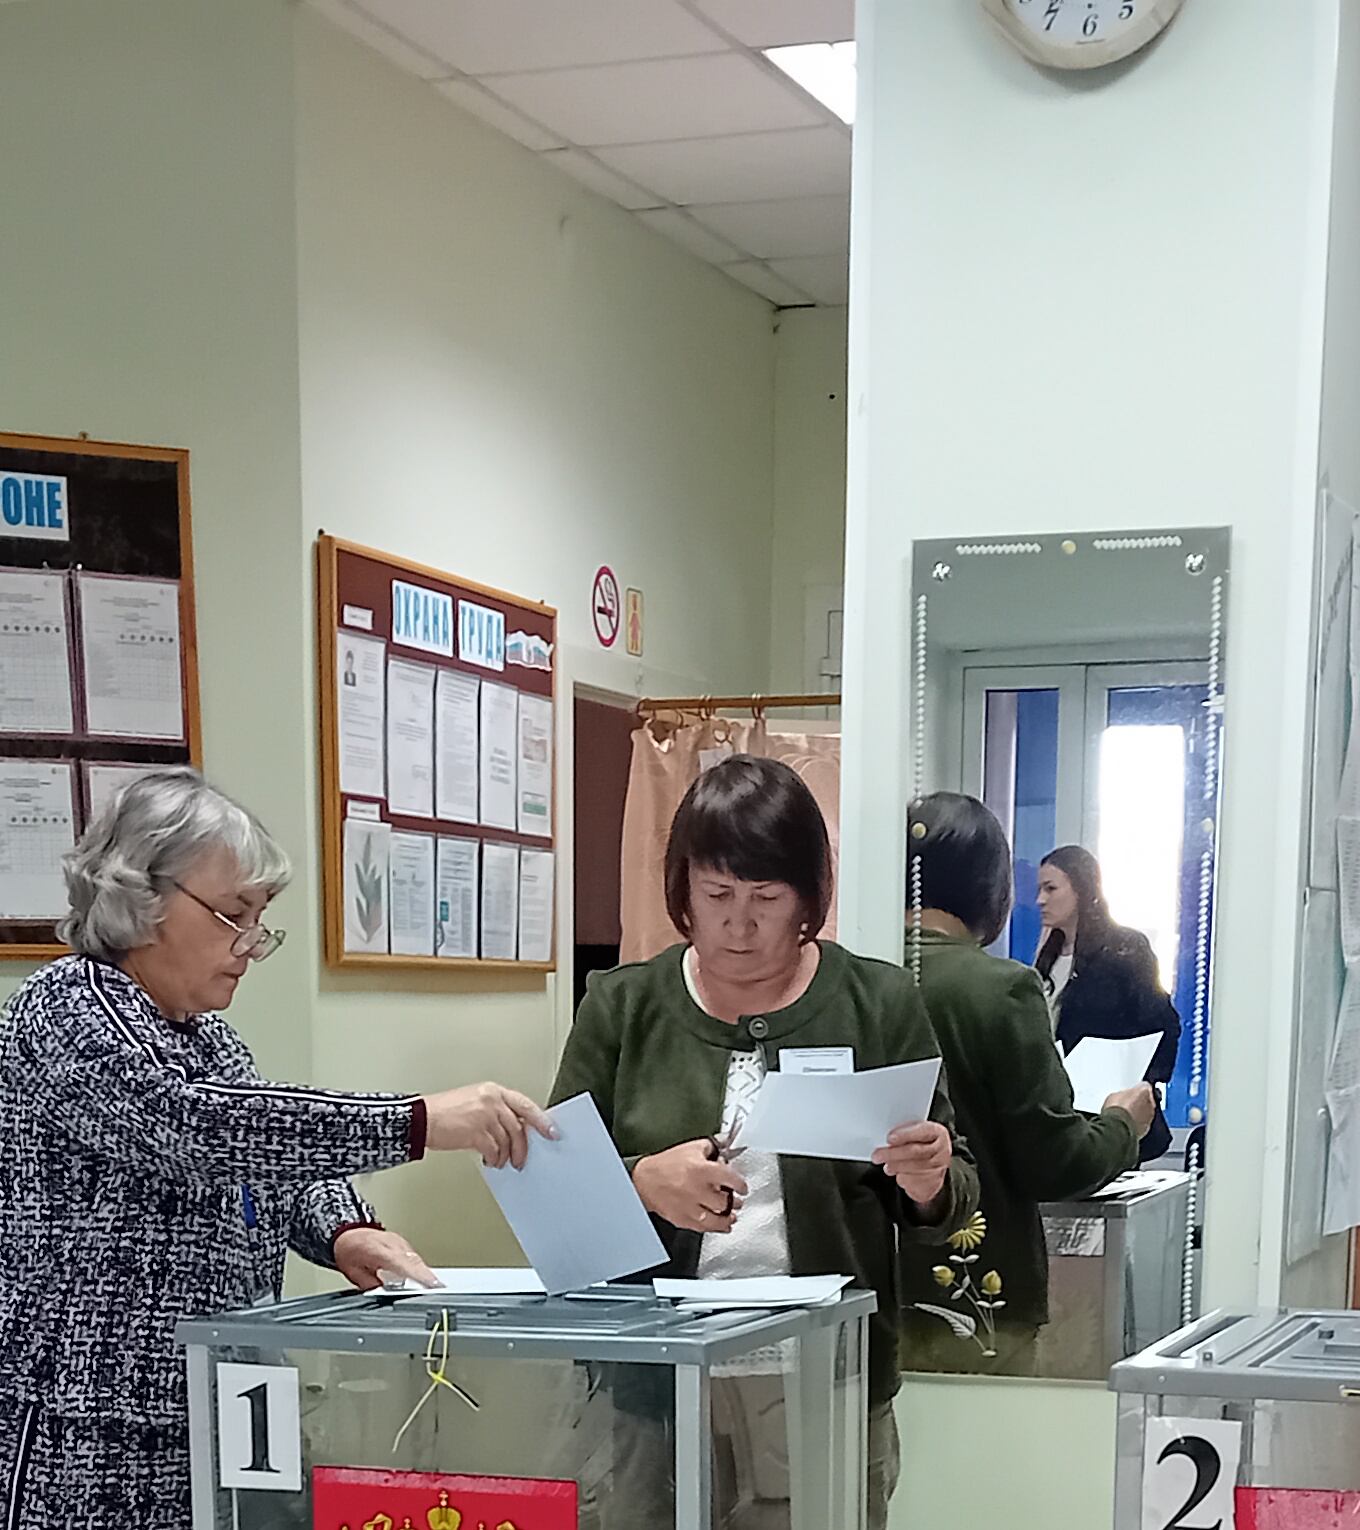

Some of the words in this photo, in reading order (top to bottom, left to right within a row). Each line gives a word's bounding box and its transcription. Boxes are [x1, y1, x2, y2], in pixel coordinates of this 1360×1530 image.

[1082, 14, 1099, 36] 6
[394, 584, 450, 647] ОХРАНА
[460, 605, 503, 665] ТРУДА
[236, 1382, 282, 1474] 1
